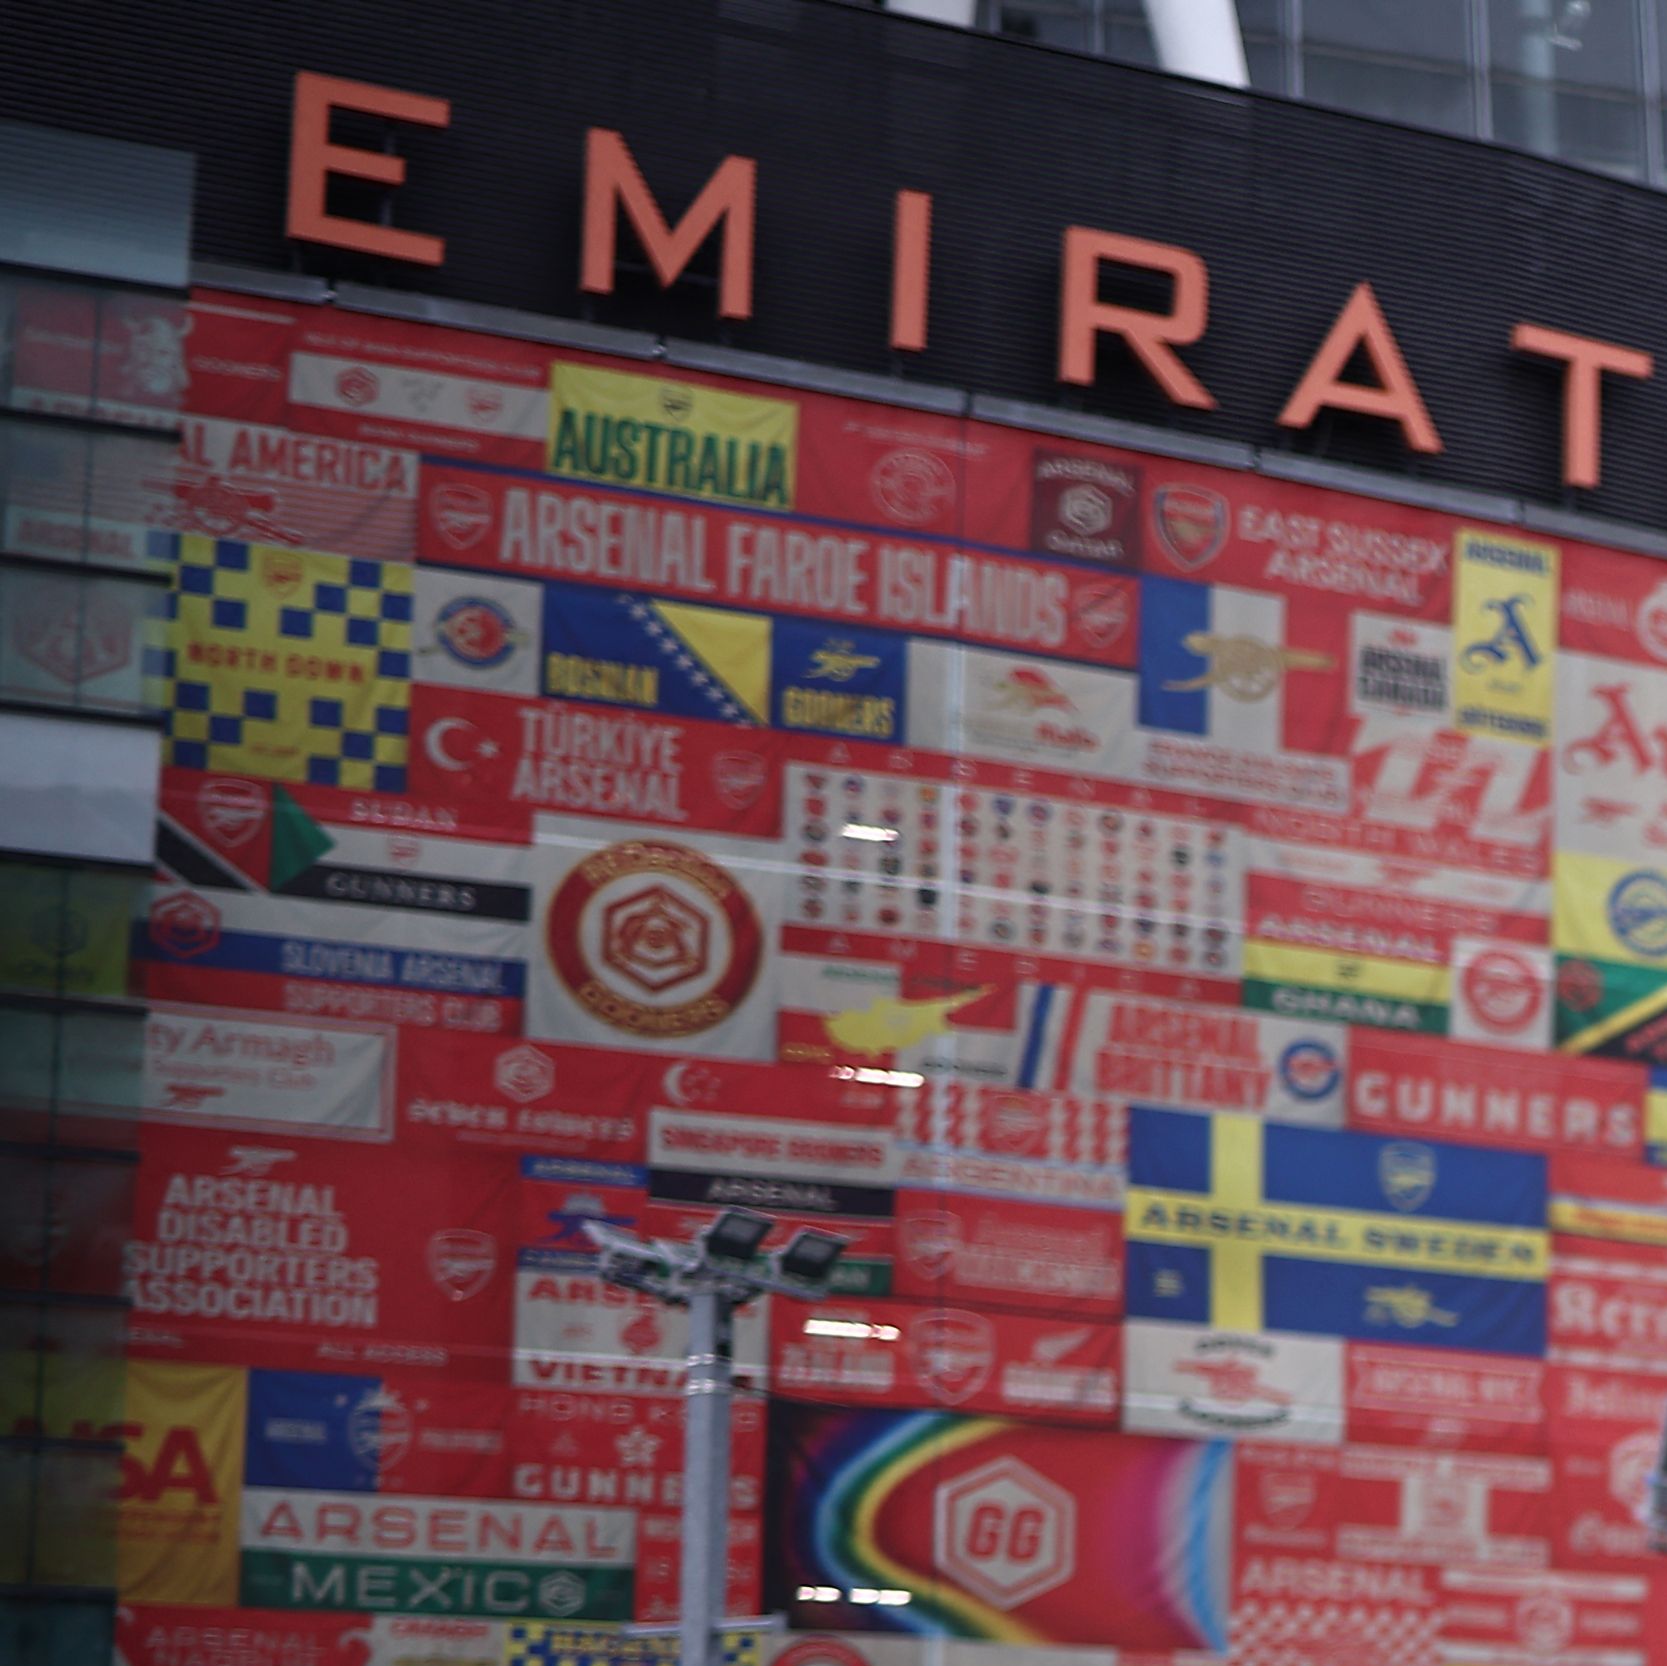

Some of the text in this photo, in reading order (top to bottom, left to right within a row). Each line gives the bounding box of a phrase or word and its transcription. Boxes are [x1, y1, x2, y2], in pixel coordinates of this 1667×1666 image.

[227, 428, 410, 495] AMERICA
[553, 409, 790, 506] AUSTRALIA
[1237, 503, 1450, 576] EAST SUSSEX
[501, 487, 1069, 648] ARSENAL FAROE ISLANDS
[1263, 551, 1425, 607] ARSENAL
[187, 640, 365, 685] NORTH DOWN
[783, 683, 895, 741] GOONERS
[509, 754, 688, 824] ARSENAL
[351, 797, 458, 832] SUDAN
[1253, 808, 1540, 874] NORTH WALES
[325, 871, 478, 908] GUNNERS
[280, 939, 392, 984] SLOVENIA
[1255, 914, 1445, 963] ARSENAL
[1273, 986, 1419, 1027] GHANA
[191, 1026, 335, 1073] Armagh
[1354, 1070, 1640, 1148] GUNNERS
[661, 1126, 783, 1162] SINGAPORE
[163, 1174, 345, 1219] ARSENAL
[156, 1208, 348, 1253] DISABLED
[1142, 1205, 1353, 1250] ARSENAL
[1364, 1228, 1536, 1266] SWEDEN
[121, 1241, 380, 1293] SUPPORTERS
[121, 1278, 380, 1329] ASSOCIATION
[517, 1396, 635, 1425] HONG
[514, 1462, 757, 1510] GUNNES
[260, 1502, 619, 1559] ARSENAL
[966, 1501, 1045, 1563] GG
[1240, 1557, 1437, 1602] ARSENAL
[145, 1625, 325, 1654] ARSENAL
